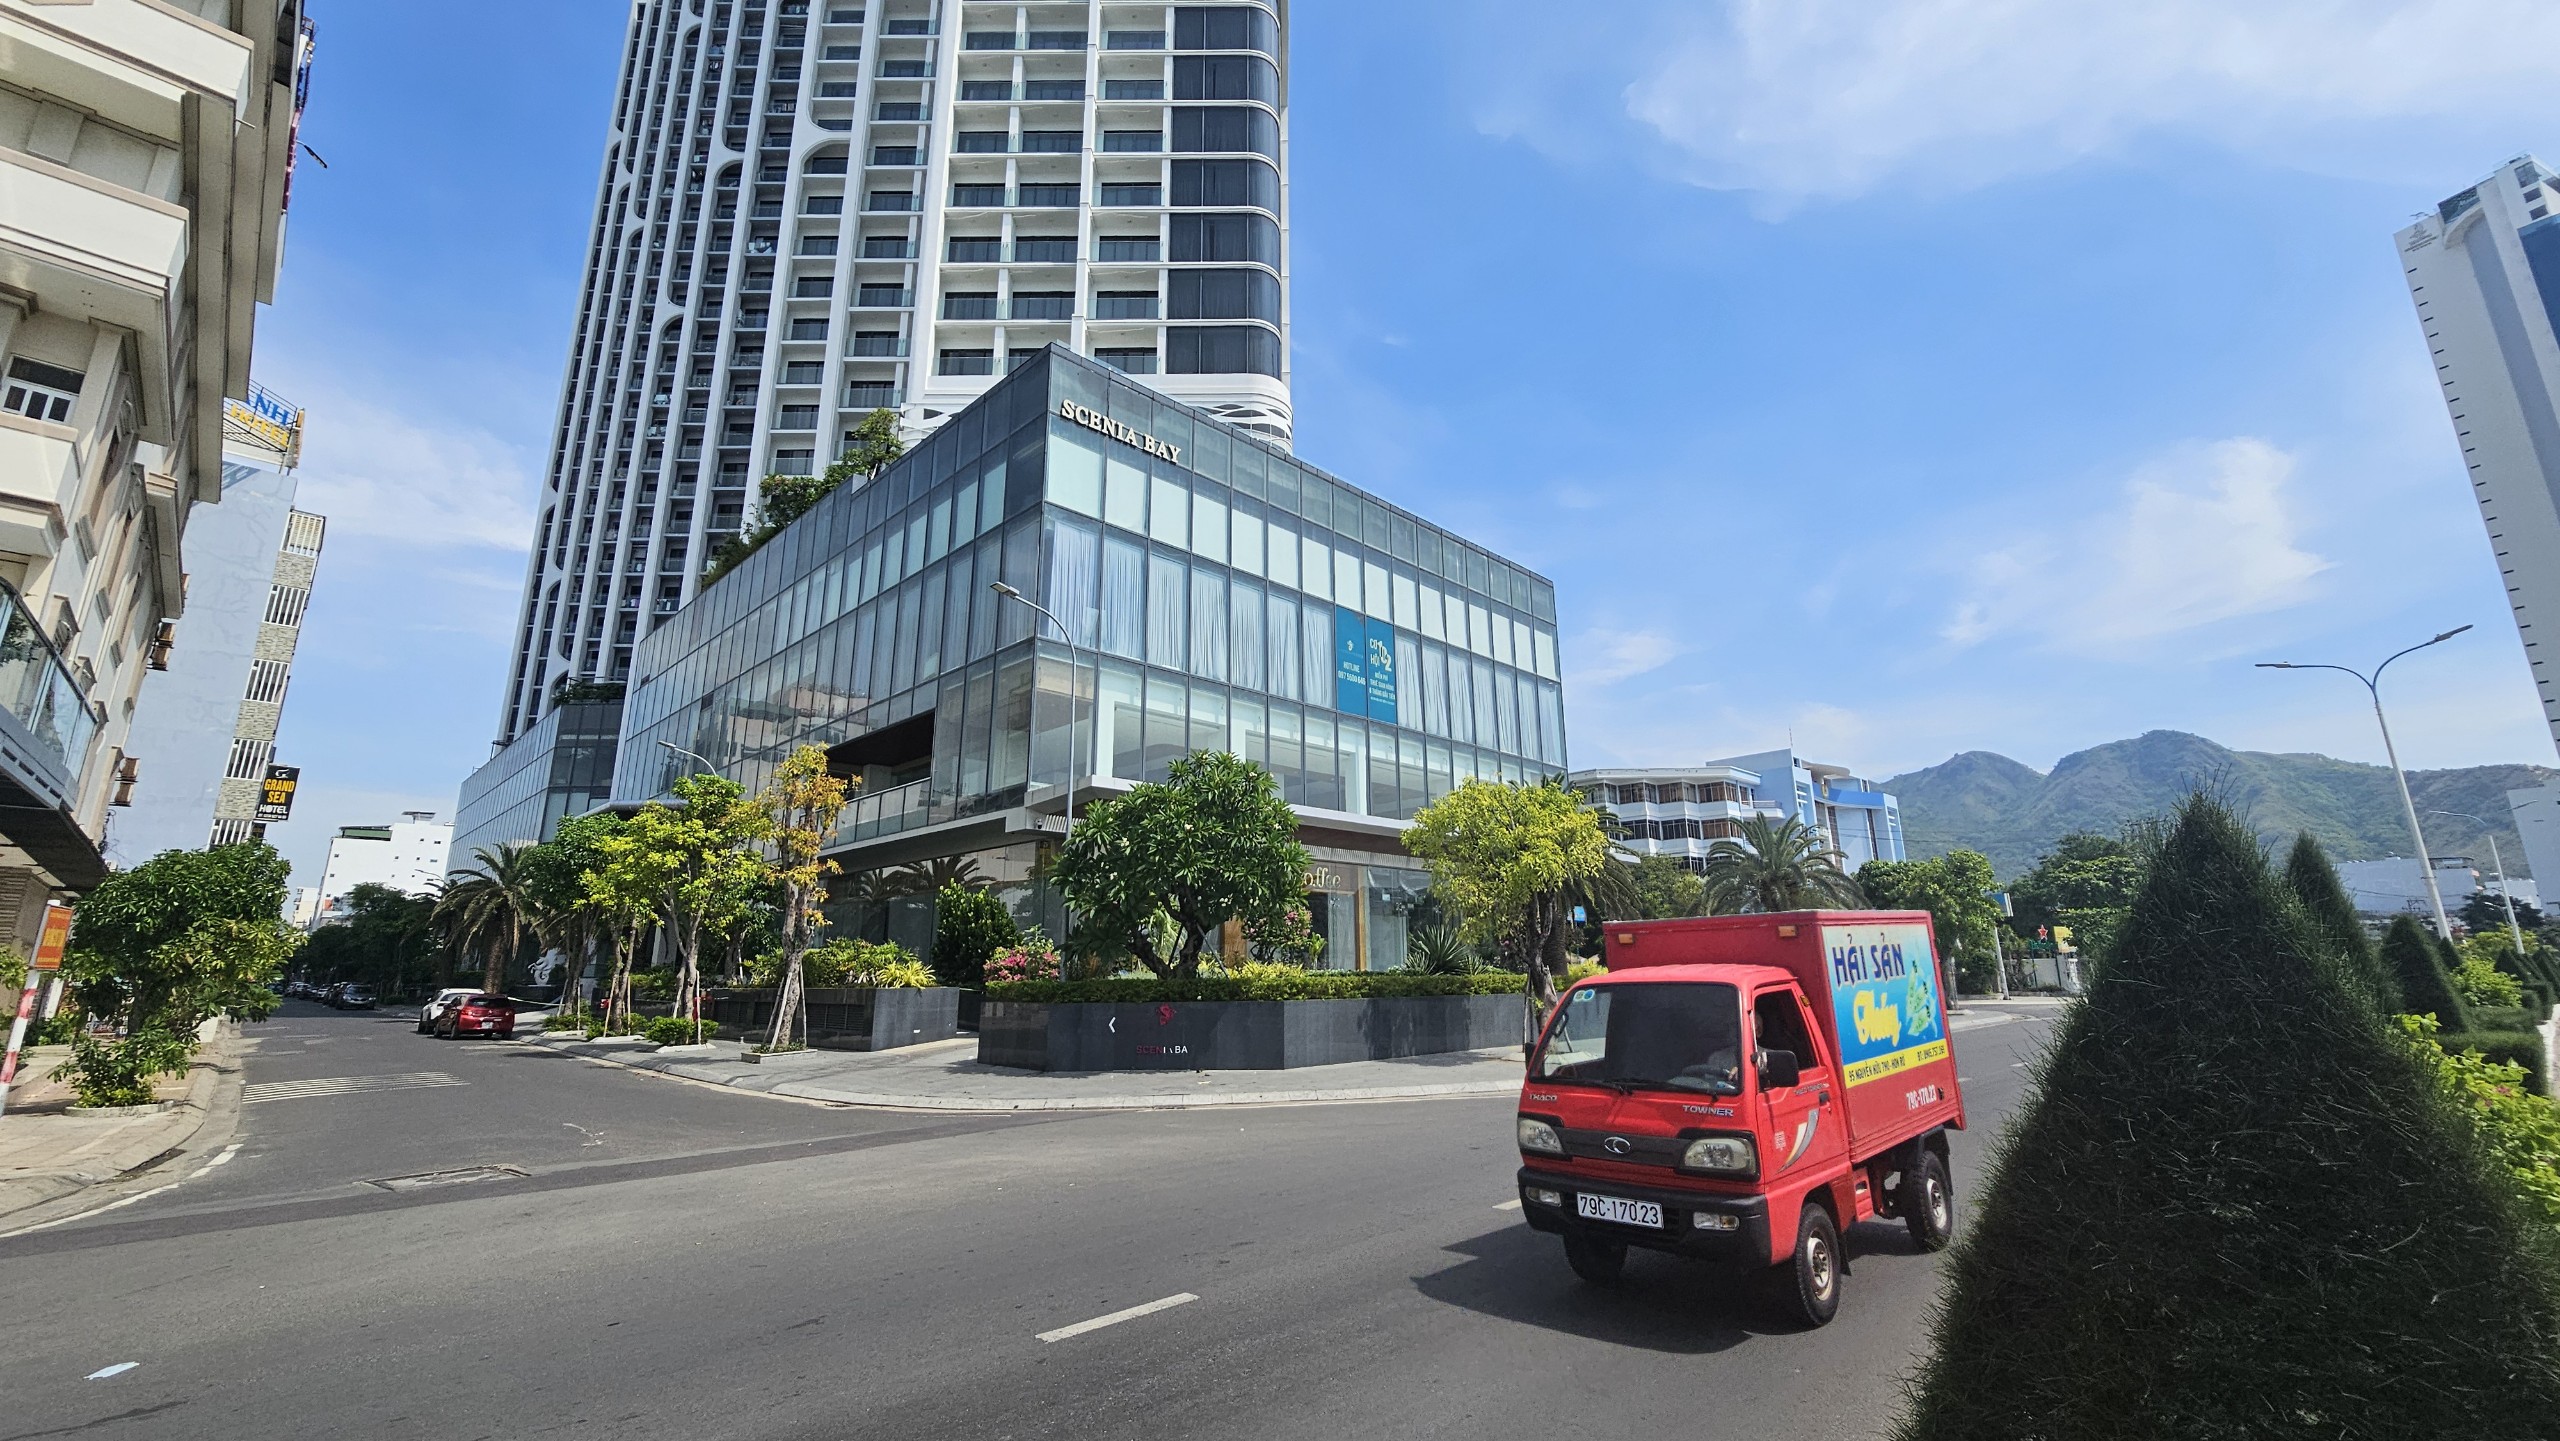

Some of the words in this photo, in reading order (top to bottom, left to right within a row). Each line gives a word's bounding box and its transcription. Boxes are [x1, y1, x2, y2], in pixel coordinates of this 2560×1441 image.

[246, 393, 290, 426] NH
[1061, 399, 1139, 449] SCENIA
[1144, 433, 1182, 463] BAY
[1343, 660, 1360, 673] HOTLINE
[264, 778, 295, 792] GRAND
[267, 791, 286, 804] SEA
[259, 804, 288, 814] HOTEL
[1303, 866, 1341, 888] offee
[1832, 933, 1868, 987] HẢI
[1870, 932, 1905, 981] SẢN
[1906, 1083, 1937, 1111] 79C-170.23
[1682, 1104, 1734, 1117] TOWNER
